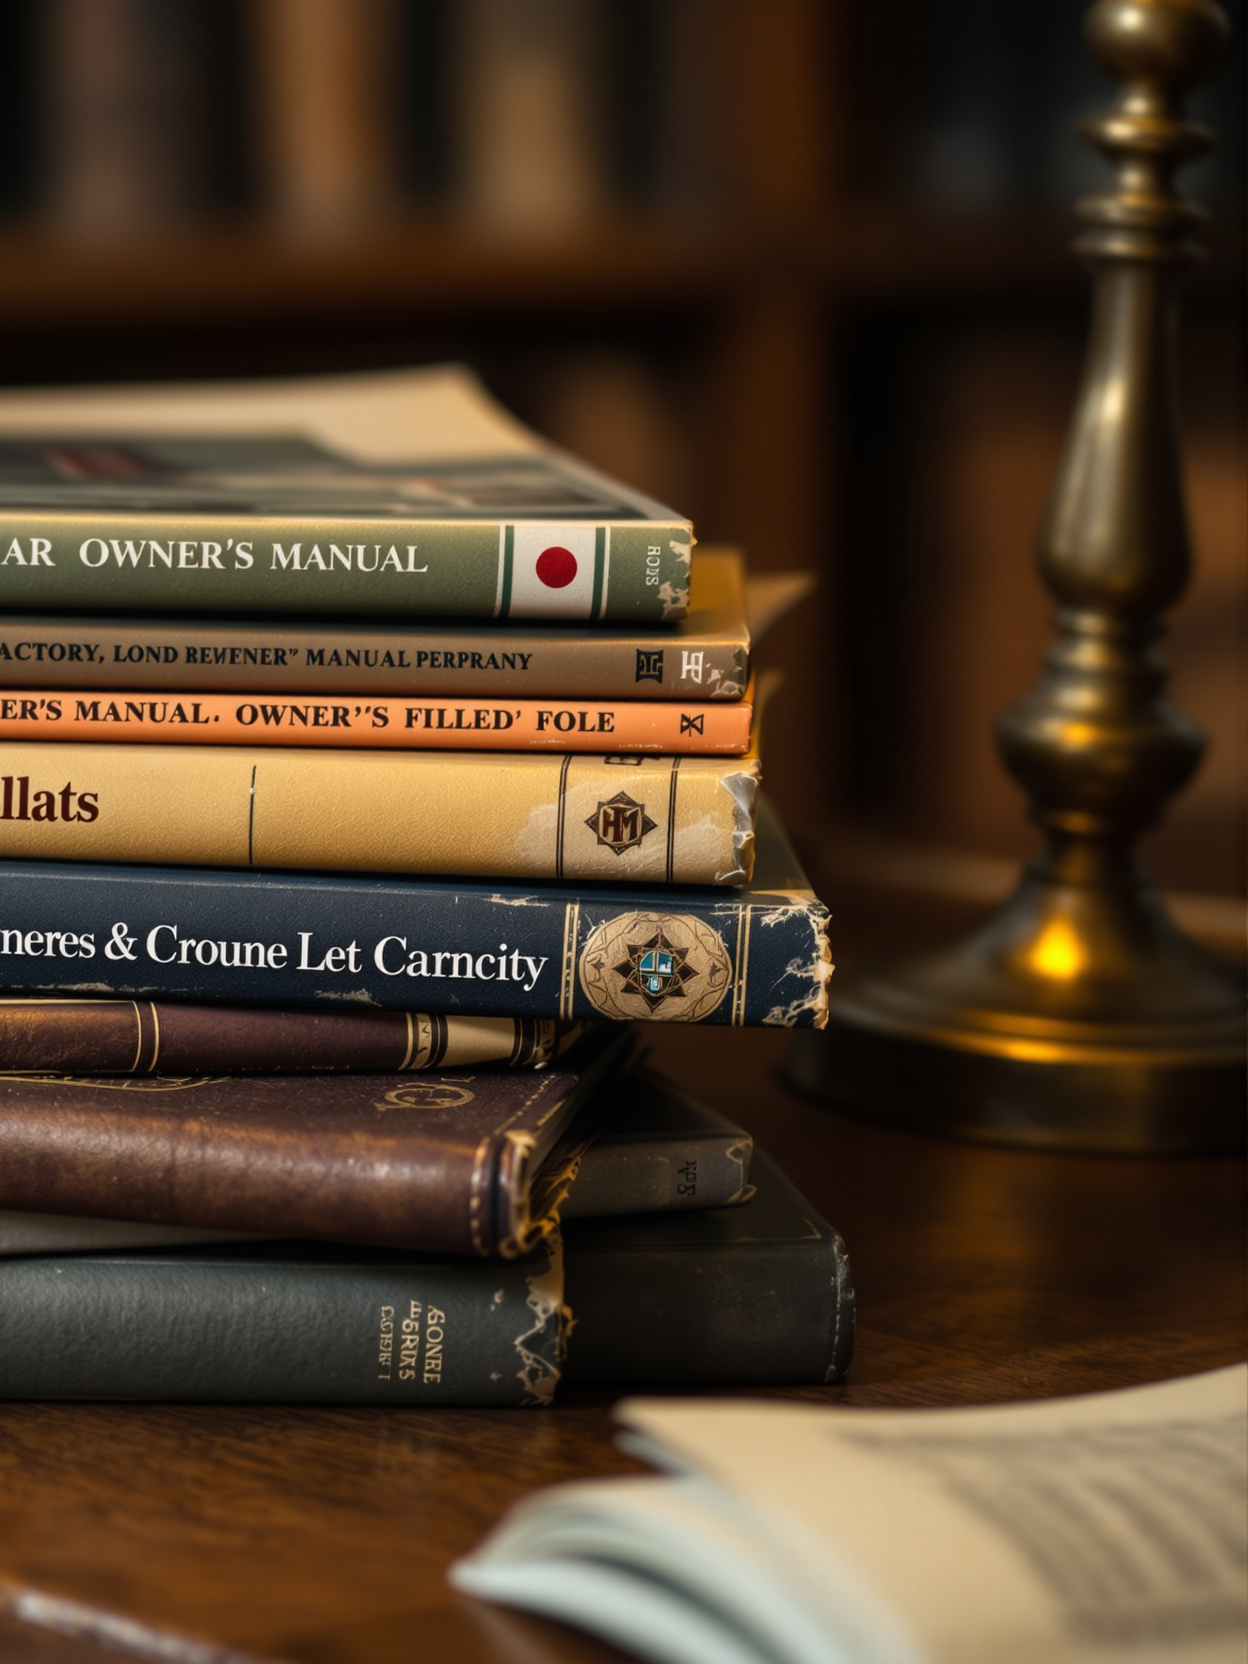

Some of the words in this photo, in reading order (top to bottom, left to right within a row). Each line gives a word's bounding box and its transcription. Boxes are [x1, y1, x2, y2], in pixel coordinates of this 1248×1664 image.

[79, 537, 254, 569] OWNER'S
[270, 542, 429, 573] MANUAL
[113, 645, 179, 664] LOND
[305, 648, 411, 668] MANUAL
[416, 650, 533, 671] PERPRANY
[535, 710, 615, 733] FOLE
[104, 921, 138, 961] &
[146, 924, 288, 969] Croune
[296, 931, 363, 973] Let
[373, 935, 549, 992] Carncity
